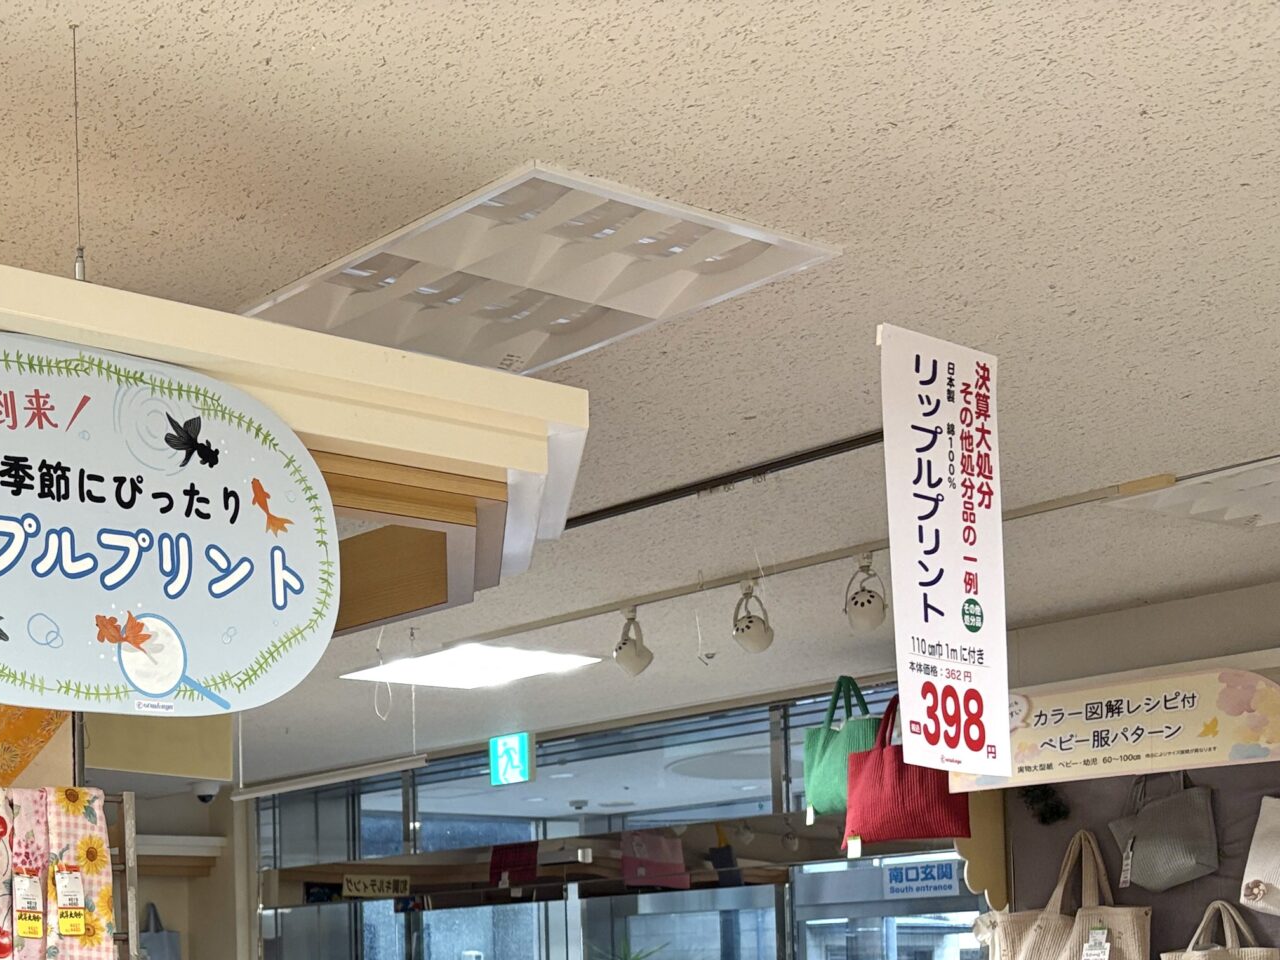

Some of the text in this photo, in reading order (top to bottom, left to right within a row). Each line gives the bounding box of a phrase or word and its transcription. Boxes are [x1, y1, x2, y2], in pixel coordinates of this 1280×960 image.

[975, 361, 994, 509] 決算大処分
[911, 354, 944, 623] リップルプリント
[960, 382, 979, 595] その他処分品の一例
[921, 681, 986, 752] 398
[1033, 691, 1197, 728] カラー図解レシピ付
[1040, 724, 1182, 752] ベビー服パターン
[888, 863, 952, 884] 南口玄関
[890, 884, 952, 894] South entrance
